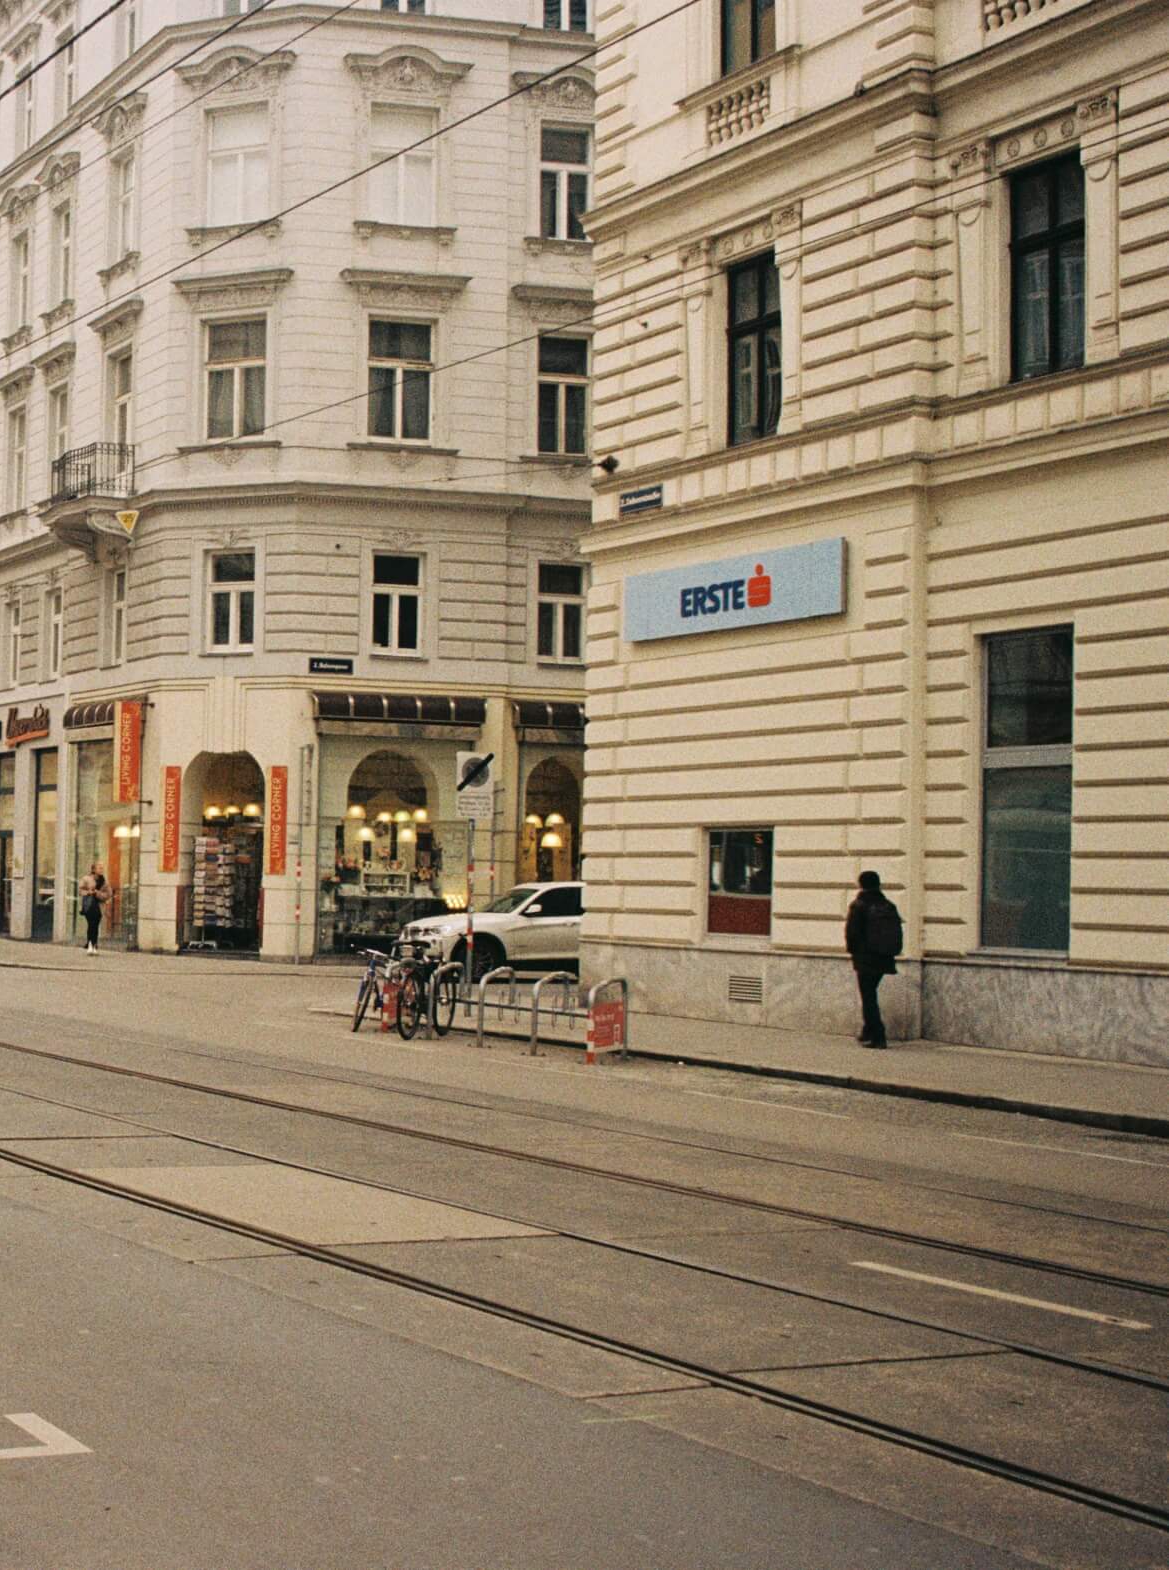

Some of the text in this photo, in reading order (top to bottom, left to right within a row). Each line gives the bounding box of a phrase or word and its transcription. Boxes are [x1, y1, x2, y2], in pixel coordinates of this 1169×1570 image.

[680, 579, 745, 617] ERSTE
[121, 712, 132, 785] LIVING CORNER
[165, 778, 176, 857] LIVING CORNER
[271, 777, 282, 858] LIVING CORNER
